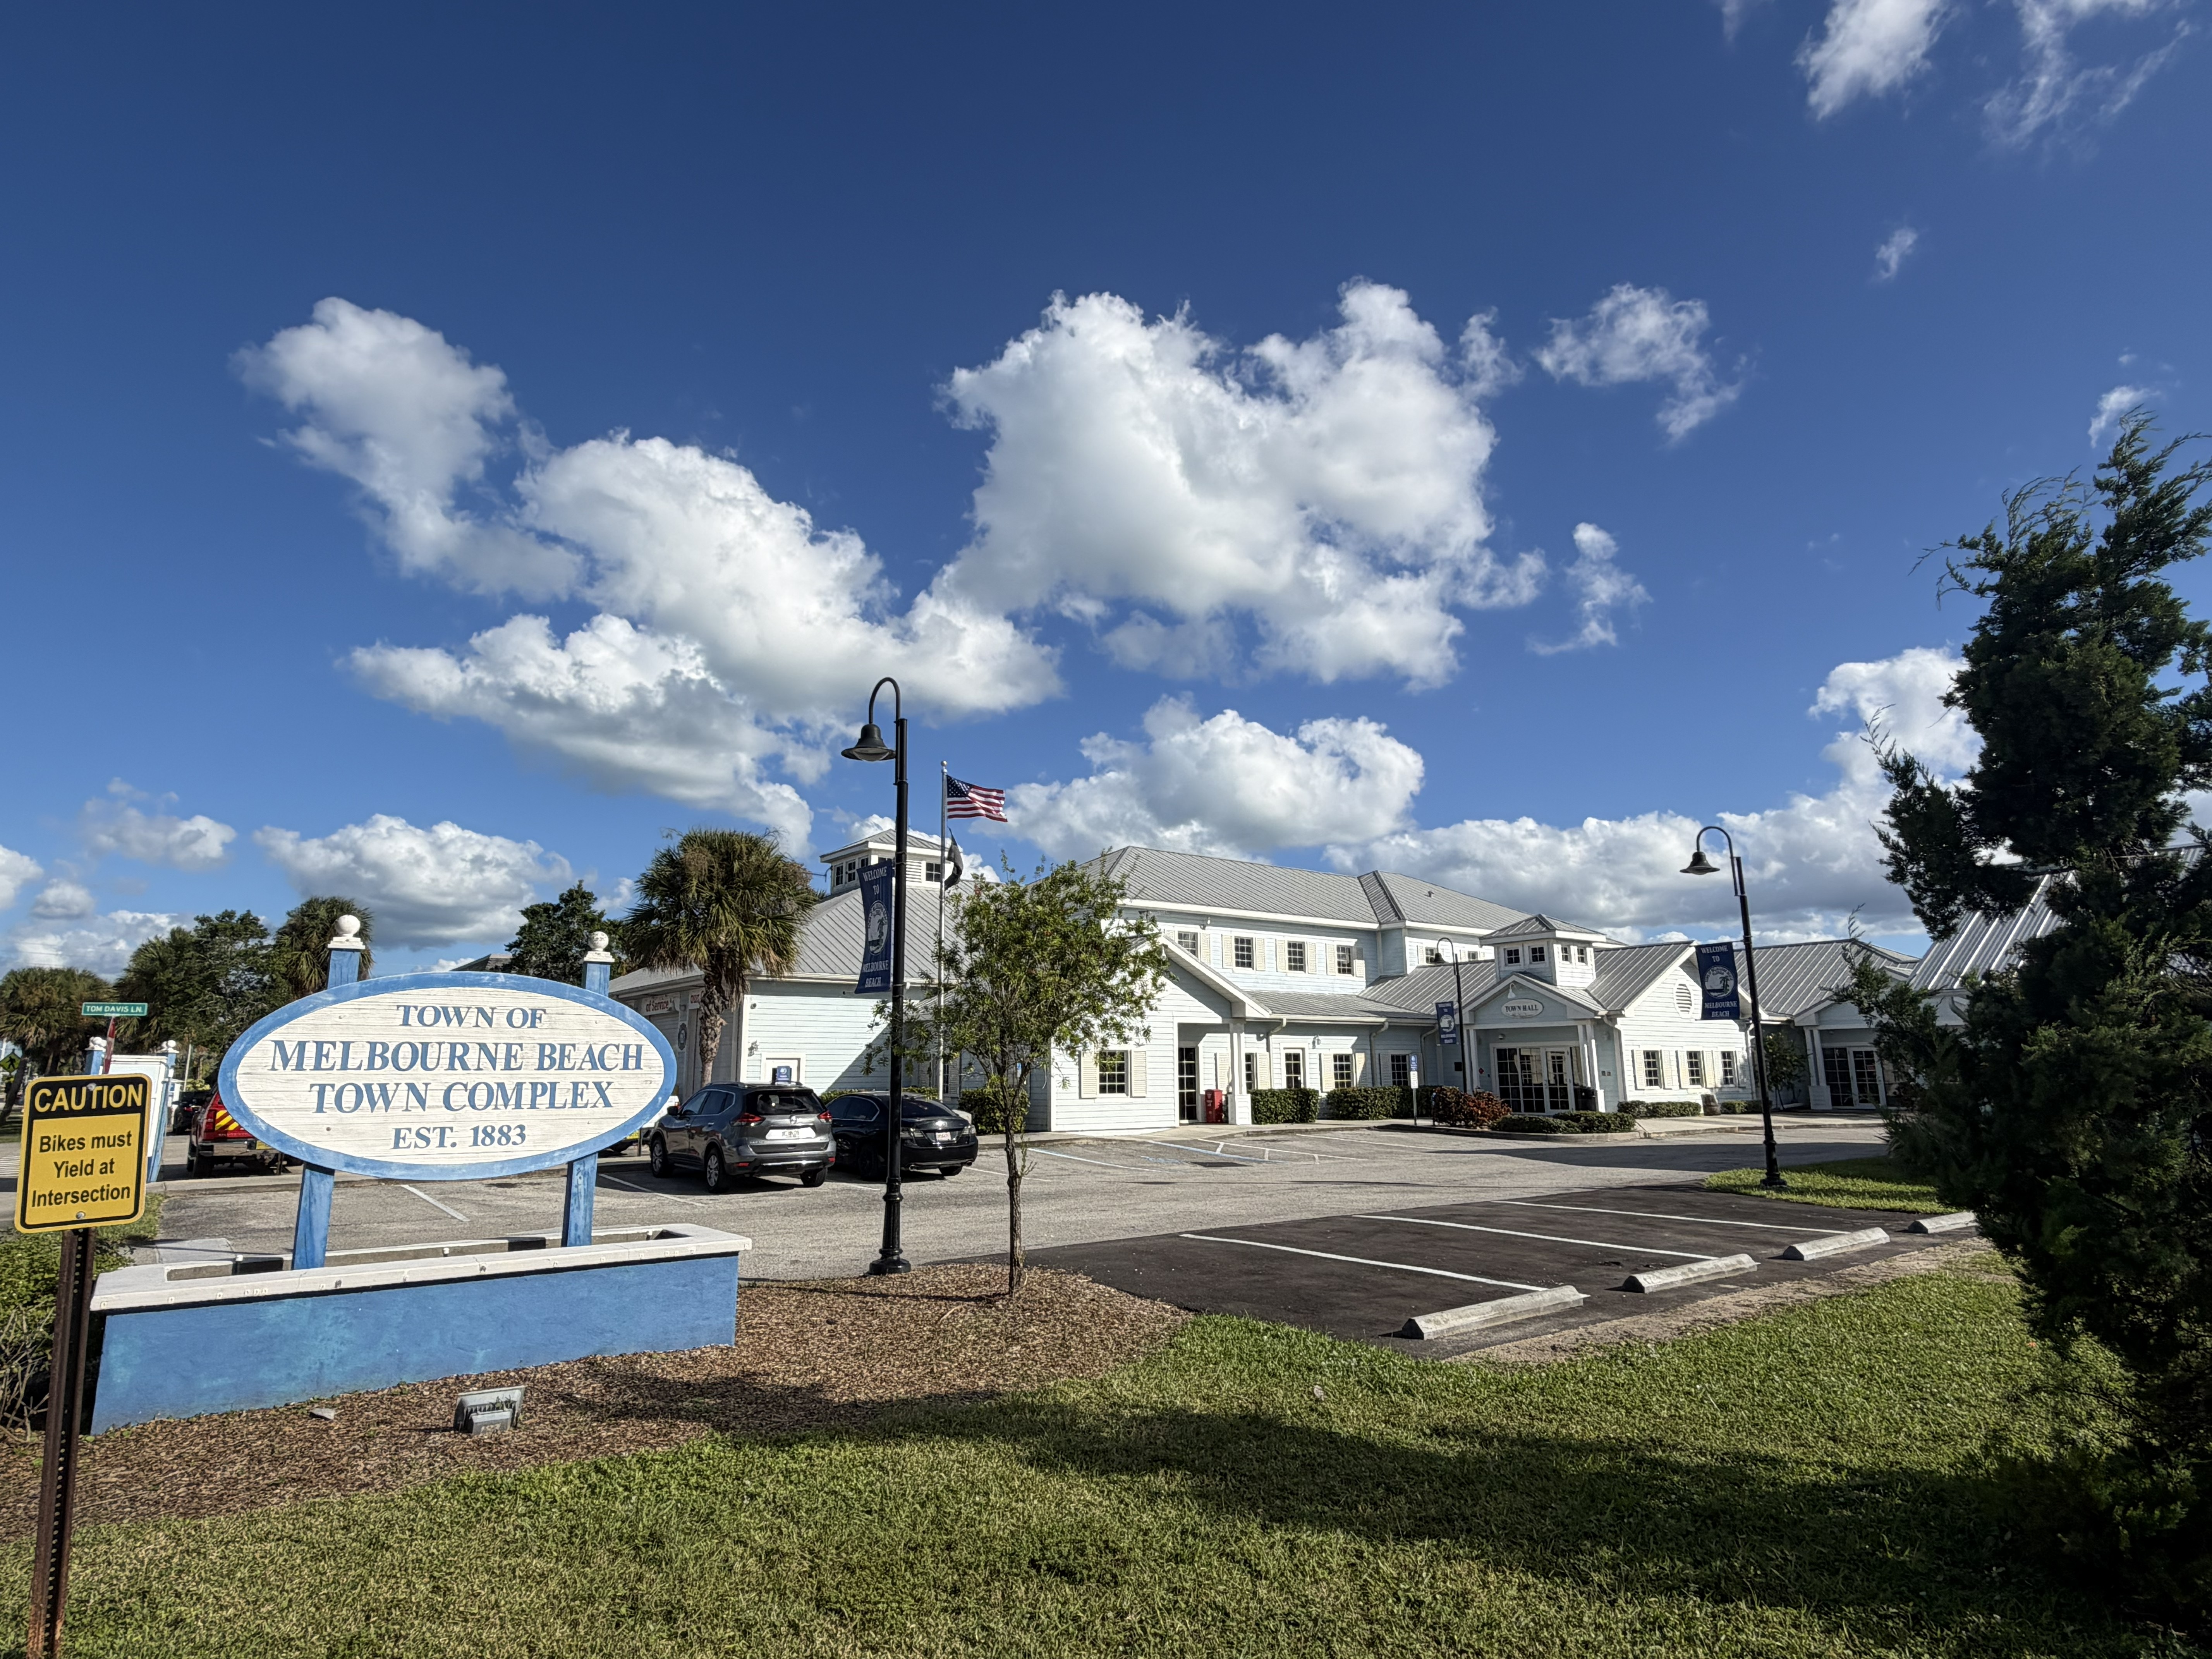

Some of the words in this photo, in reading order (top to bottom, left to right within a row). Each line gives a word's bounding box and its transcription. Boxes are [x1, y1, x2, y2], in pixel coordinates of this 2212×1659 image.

[863, 866, 887, 881] WELCOME
[873, 884, 879, 895] TO
[1701, 945, 1728, 953] WELCOME
[862, 960, 888, 972] MELBOURNE
[865, 977, 881, 988] BEACH
[397, 1005, 494, 1027] TOWN
[506, 1008, 546, 1029] OF
[268, 1040, 523, 1071] MELBOURNE
[534, 1043, 643, 1071] BEACH
[35, 1084, 143, 1112] CAUTION
[309, 1082, 431, 1113] TOWN
[443, 1081, 613, 1111] COMPLEX
[40, 1135, 85, 1152] Bikes
[91, 1130, 132, 1149] must
[392, 1126, 458, 1150] EST.
[469, 1124, 526, 1147] 1883
[53, 1159, 94, 1178] Yield
[99, 1158, 115, 1175] at
[32, 1183, 130, 1207] Intersection
